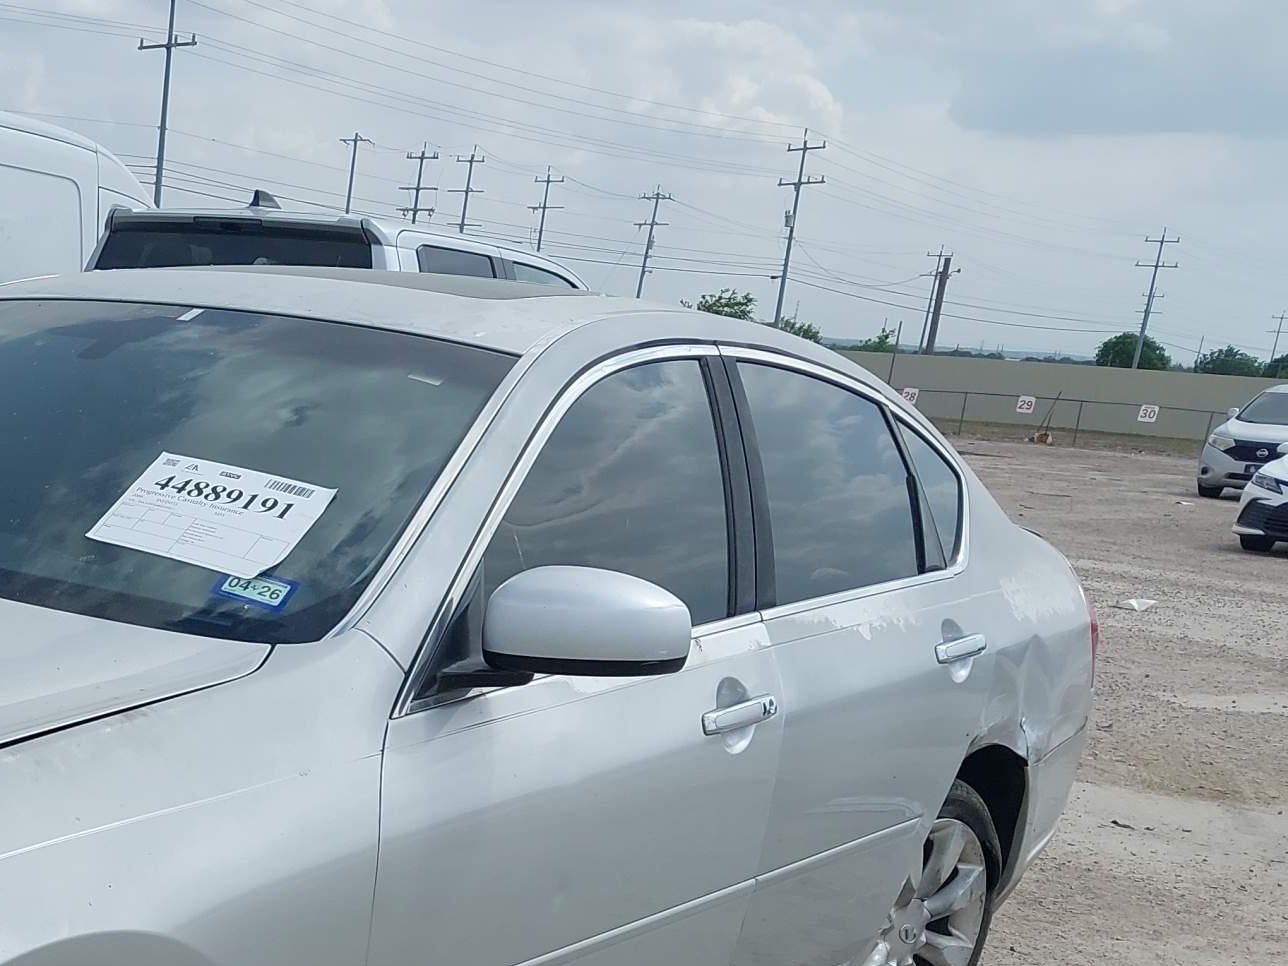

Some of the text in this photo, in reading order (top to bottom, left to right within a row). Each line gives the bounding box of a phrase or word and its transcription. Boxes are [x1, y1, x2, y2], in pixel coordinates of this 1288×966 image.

[903, 391, 916, 401] 28
[1018, 399, 1033, 410] 29
[1140, 408, 1156, 418] 30
[154, 475, 295, 519] 44889191
[208, 503, 244, 515] Insurance
[228, 577, 252, 591] 04
[257, 585, 282, 600] 26
